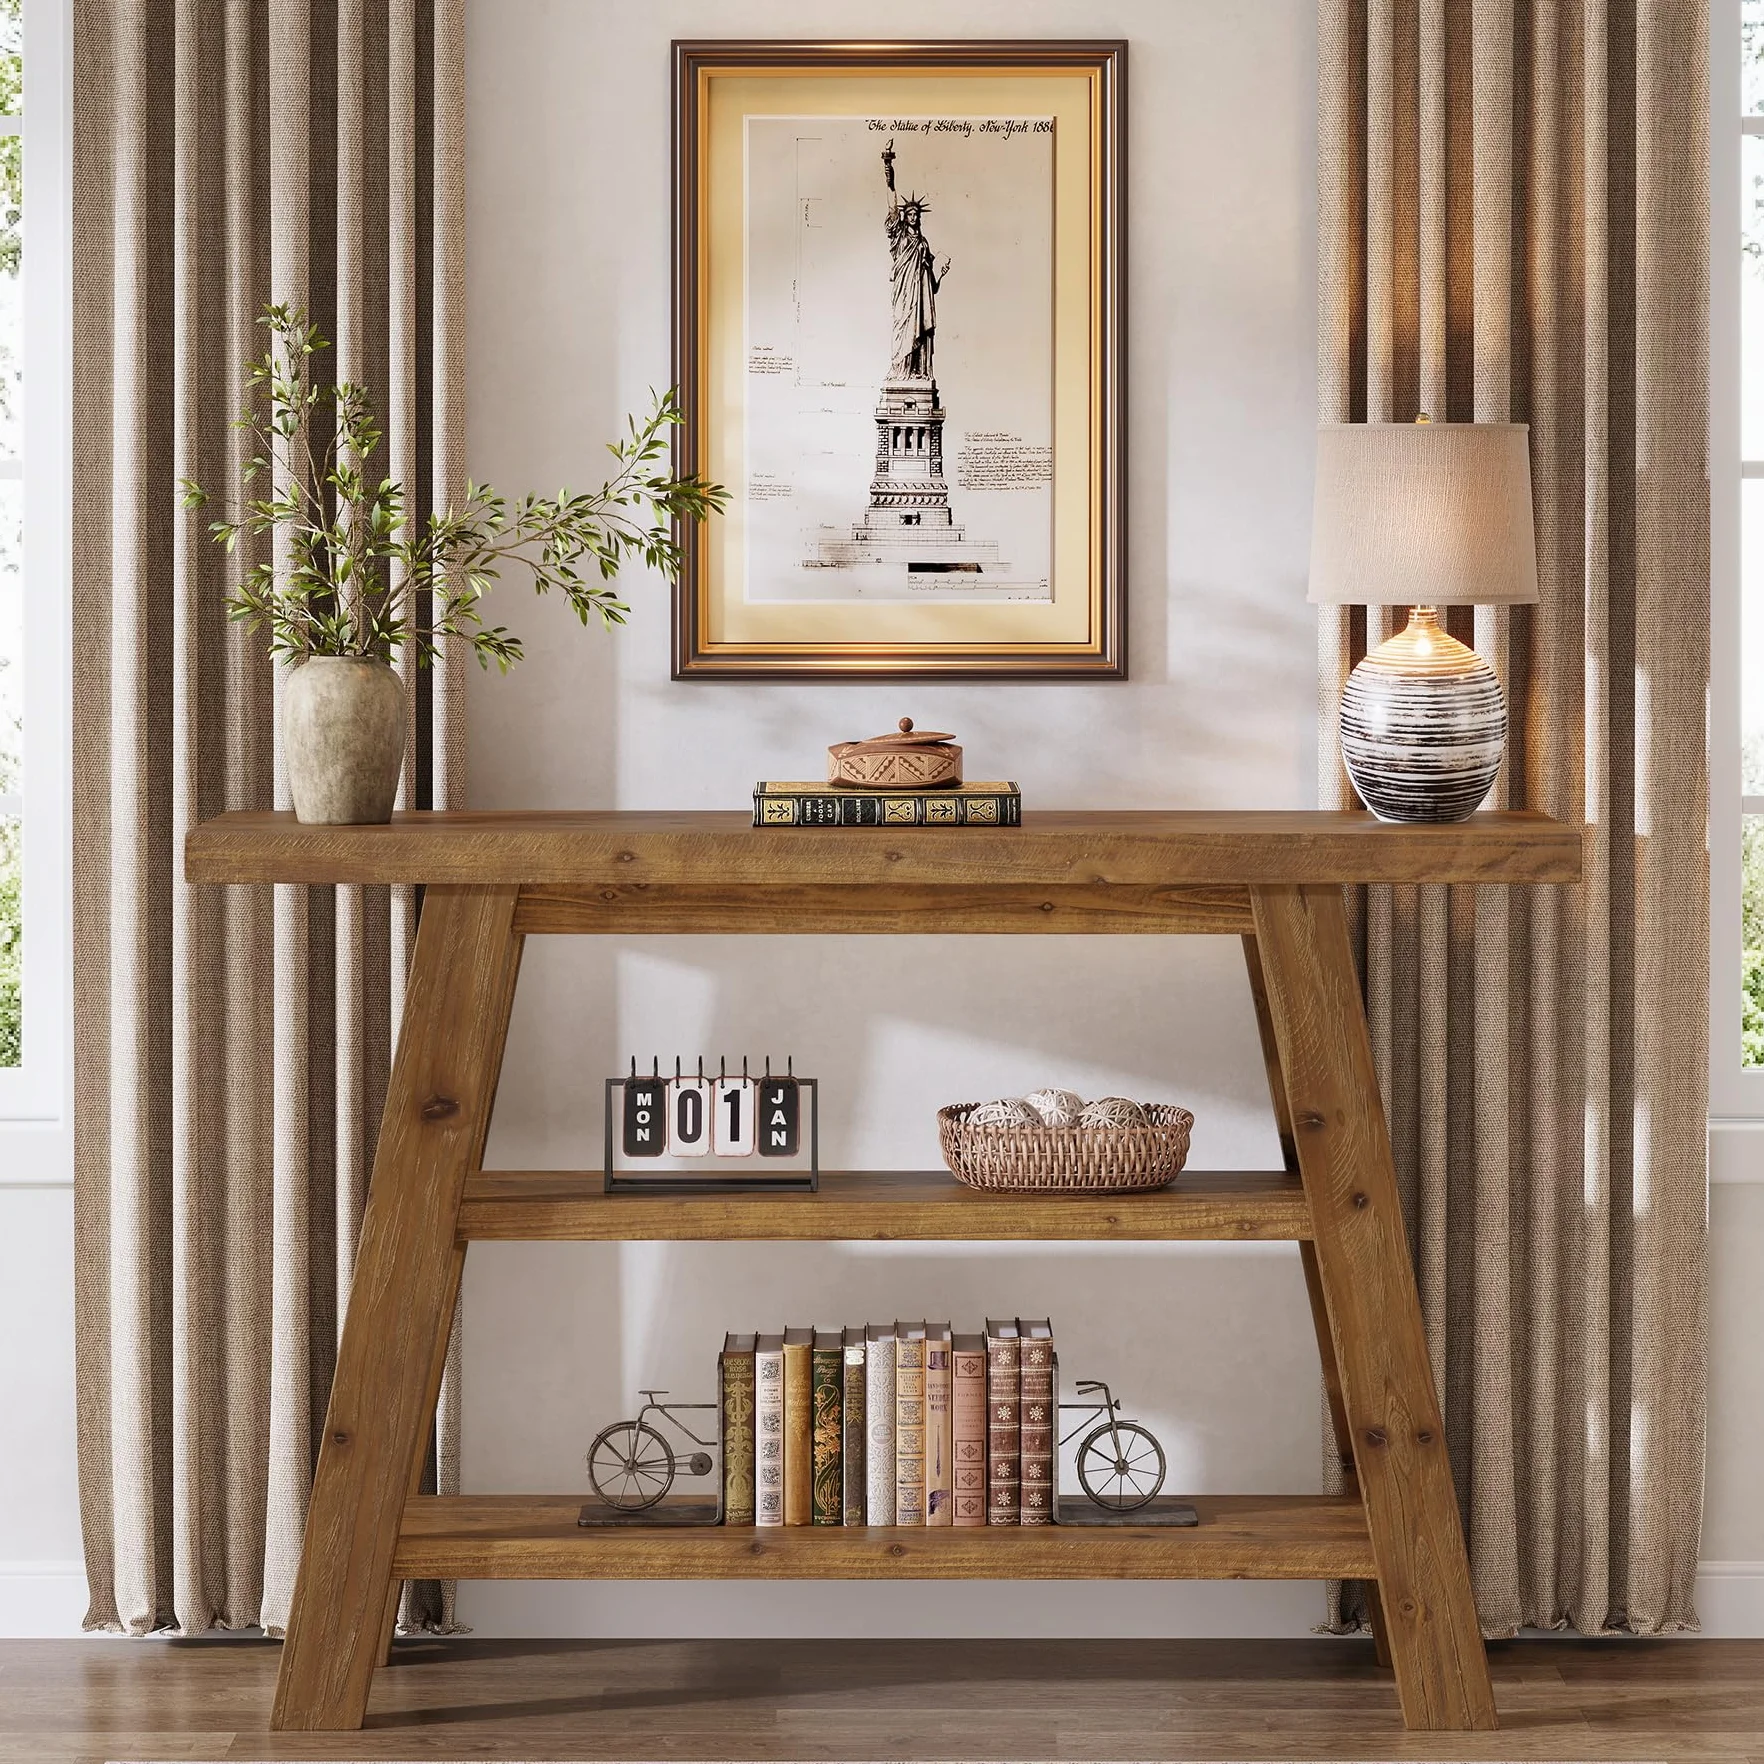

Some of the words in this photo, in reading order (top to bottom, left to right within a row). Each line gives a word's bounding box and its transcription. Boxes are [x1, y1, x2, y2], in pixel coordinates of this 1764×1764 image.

[890, 119, 919, 131] Statue
[921, 119, 934, 135] of
[636, 1092, 652, 1142] MON
[770, 1088, 787, 1147] JAN
